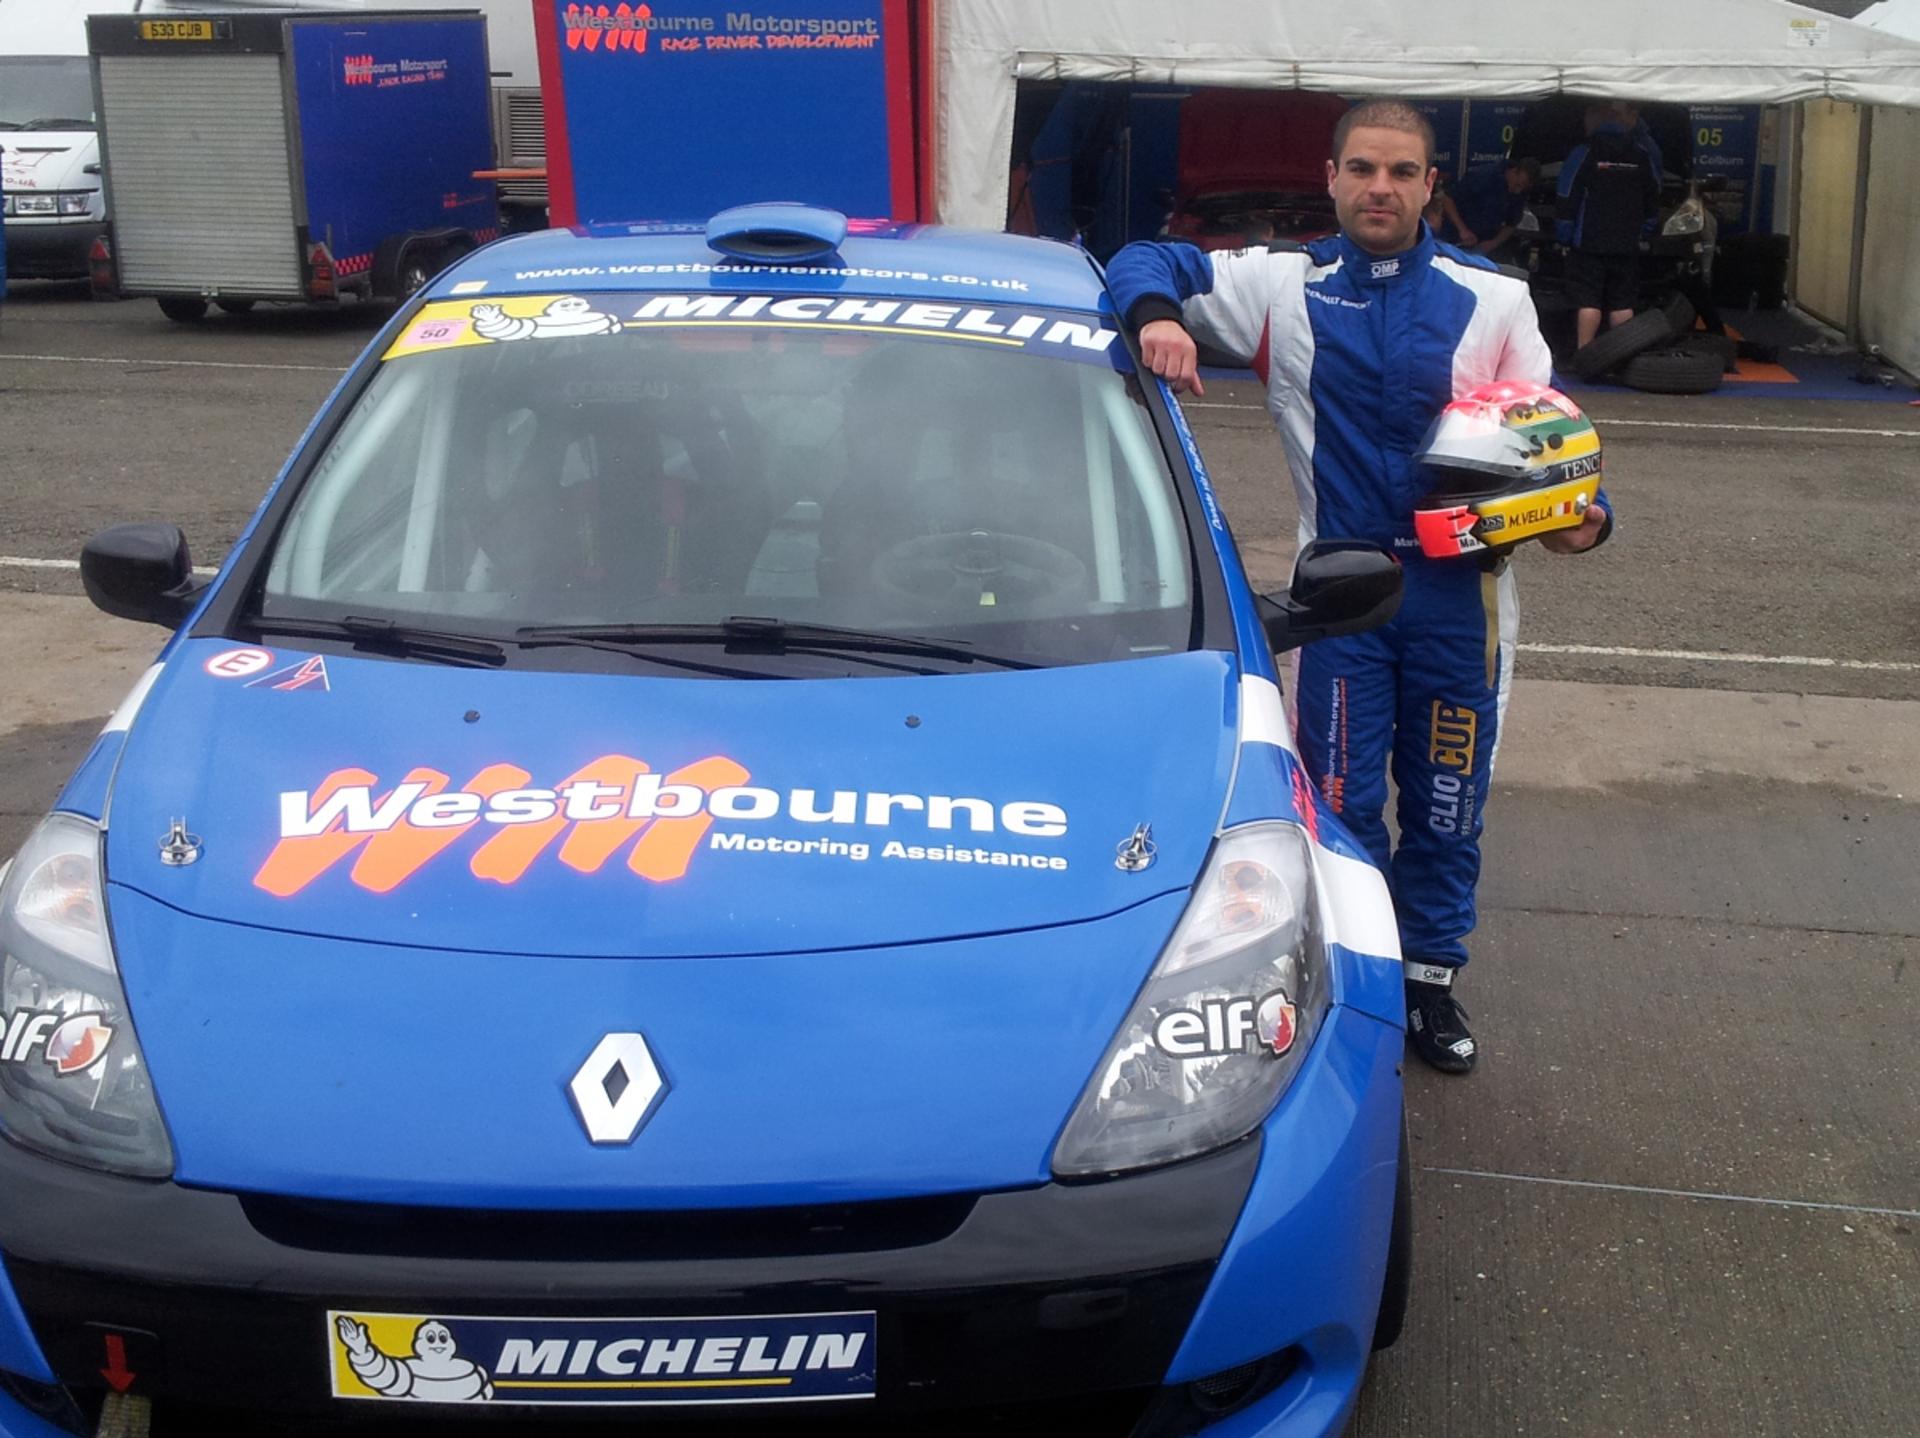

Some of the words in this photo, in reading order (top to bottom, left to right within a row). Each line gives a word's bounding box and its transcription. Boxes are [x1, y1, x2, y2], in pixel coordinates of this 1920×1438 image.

[562, 11, 715, 31] Westbourne
[726, 12, 878, 35] Motorsport
[661, 37, 702, 51] RACE
[705, 35, 762, 49] DRIVER
[766, 34, 880, 49] DEVELOPMENT
[1696, 127, 1723, 147] 05
[515, 263, 1030, 292] www.westbournemotors.co.uk
[1371, 259, 1400, 278] OMP
[420, 327, 450, 340] 50
[632, 295, 1120, 352] MICHELIN
[1431, 701, 1476, 774] CUP
[280, 773, 1068, 838] Westbourne
[1429, 774, 1462, 834] CLIO
[710, 832, 870, 861] Motoring
[881, 840, 1068, 871] Assistance
[0, 1012, 58, 1062] lf
[1157, 1001, 1254, 1054] elf
[494, 1332, 868, 1376] MICHELIN
